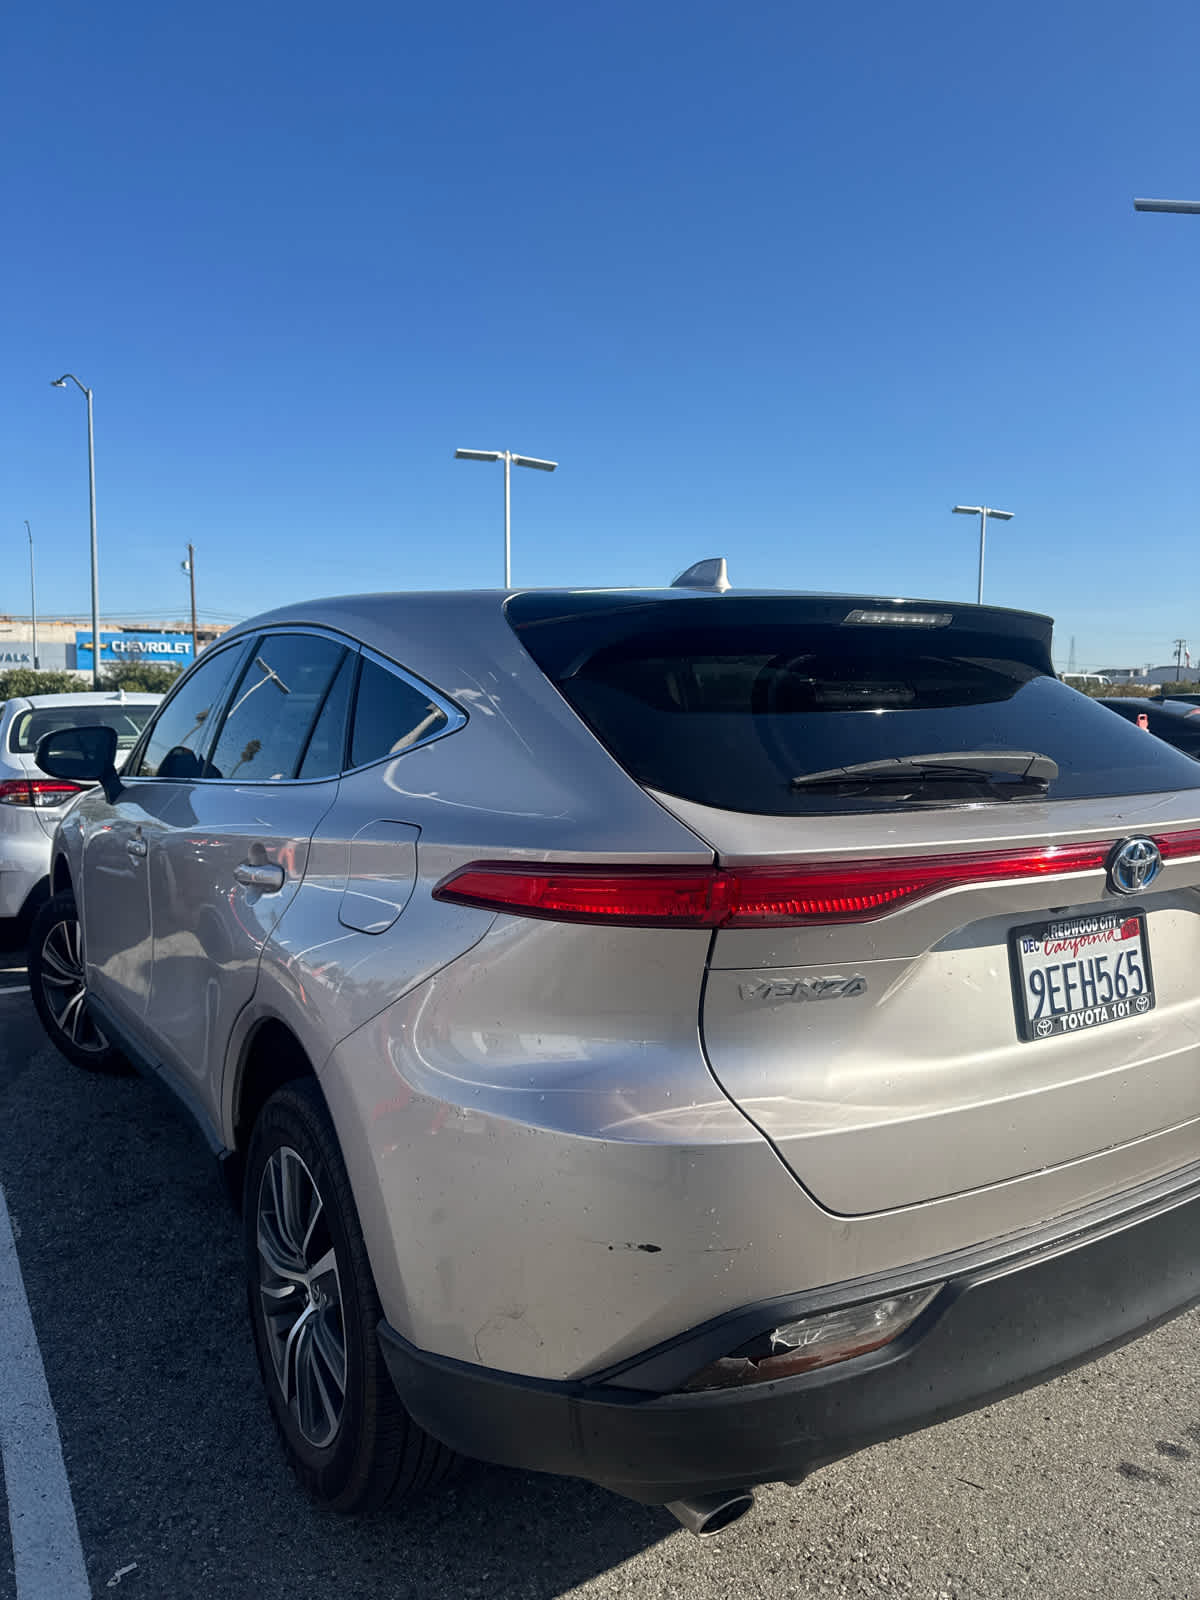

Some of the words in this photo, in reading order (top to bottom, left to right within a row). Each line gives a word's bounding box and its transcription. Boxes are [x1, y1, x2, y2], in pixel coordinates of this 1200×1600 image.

[111, 640, 191, 654] CHEVROLET
[1051, 919, 1098, 938] REDWOOD
[1099, 915, 1118, 930] CITY
[1023, 939, 1039, 953] DEC
[1043, 930, 1120, 958] California
[738, 975, 867, 1001] VENZA
[1029, 949, 1143, 1019] 9EFH565
[1060, 1006, 1109, 1030] TOYOTA
[1111, 1001, 1131, 1016] 101
